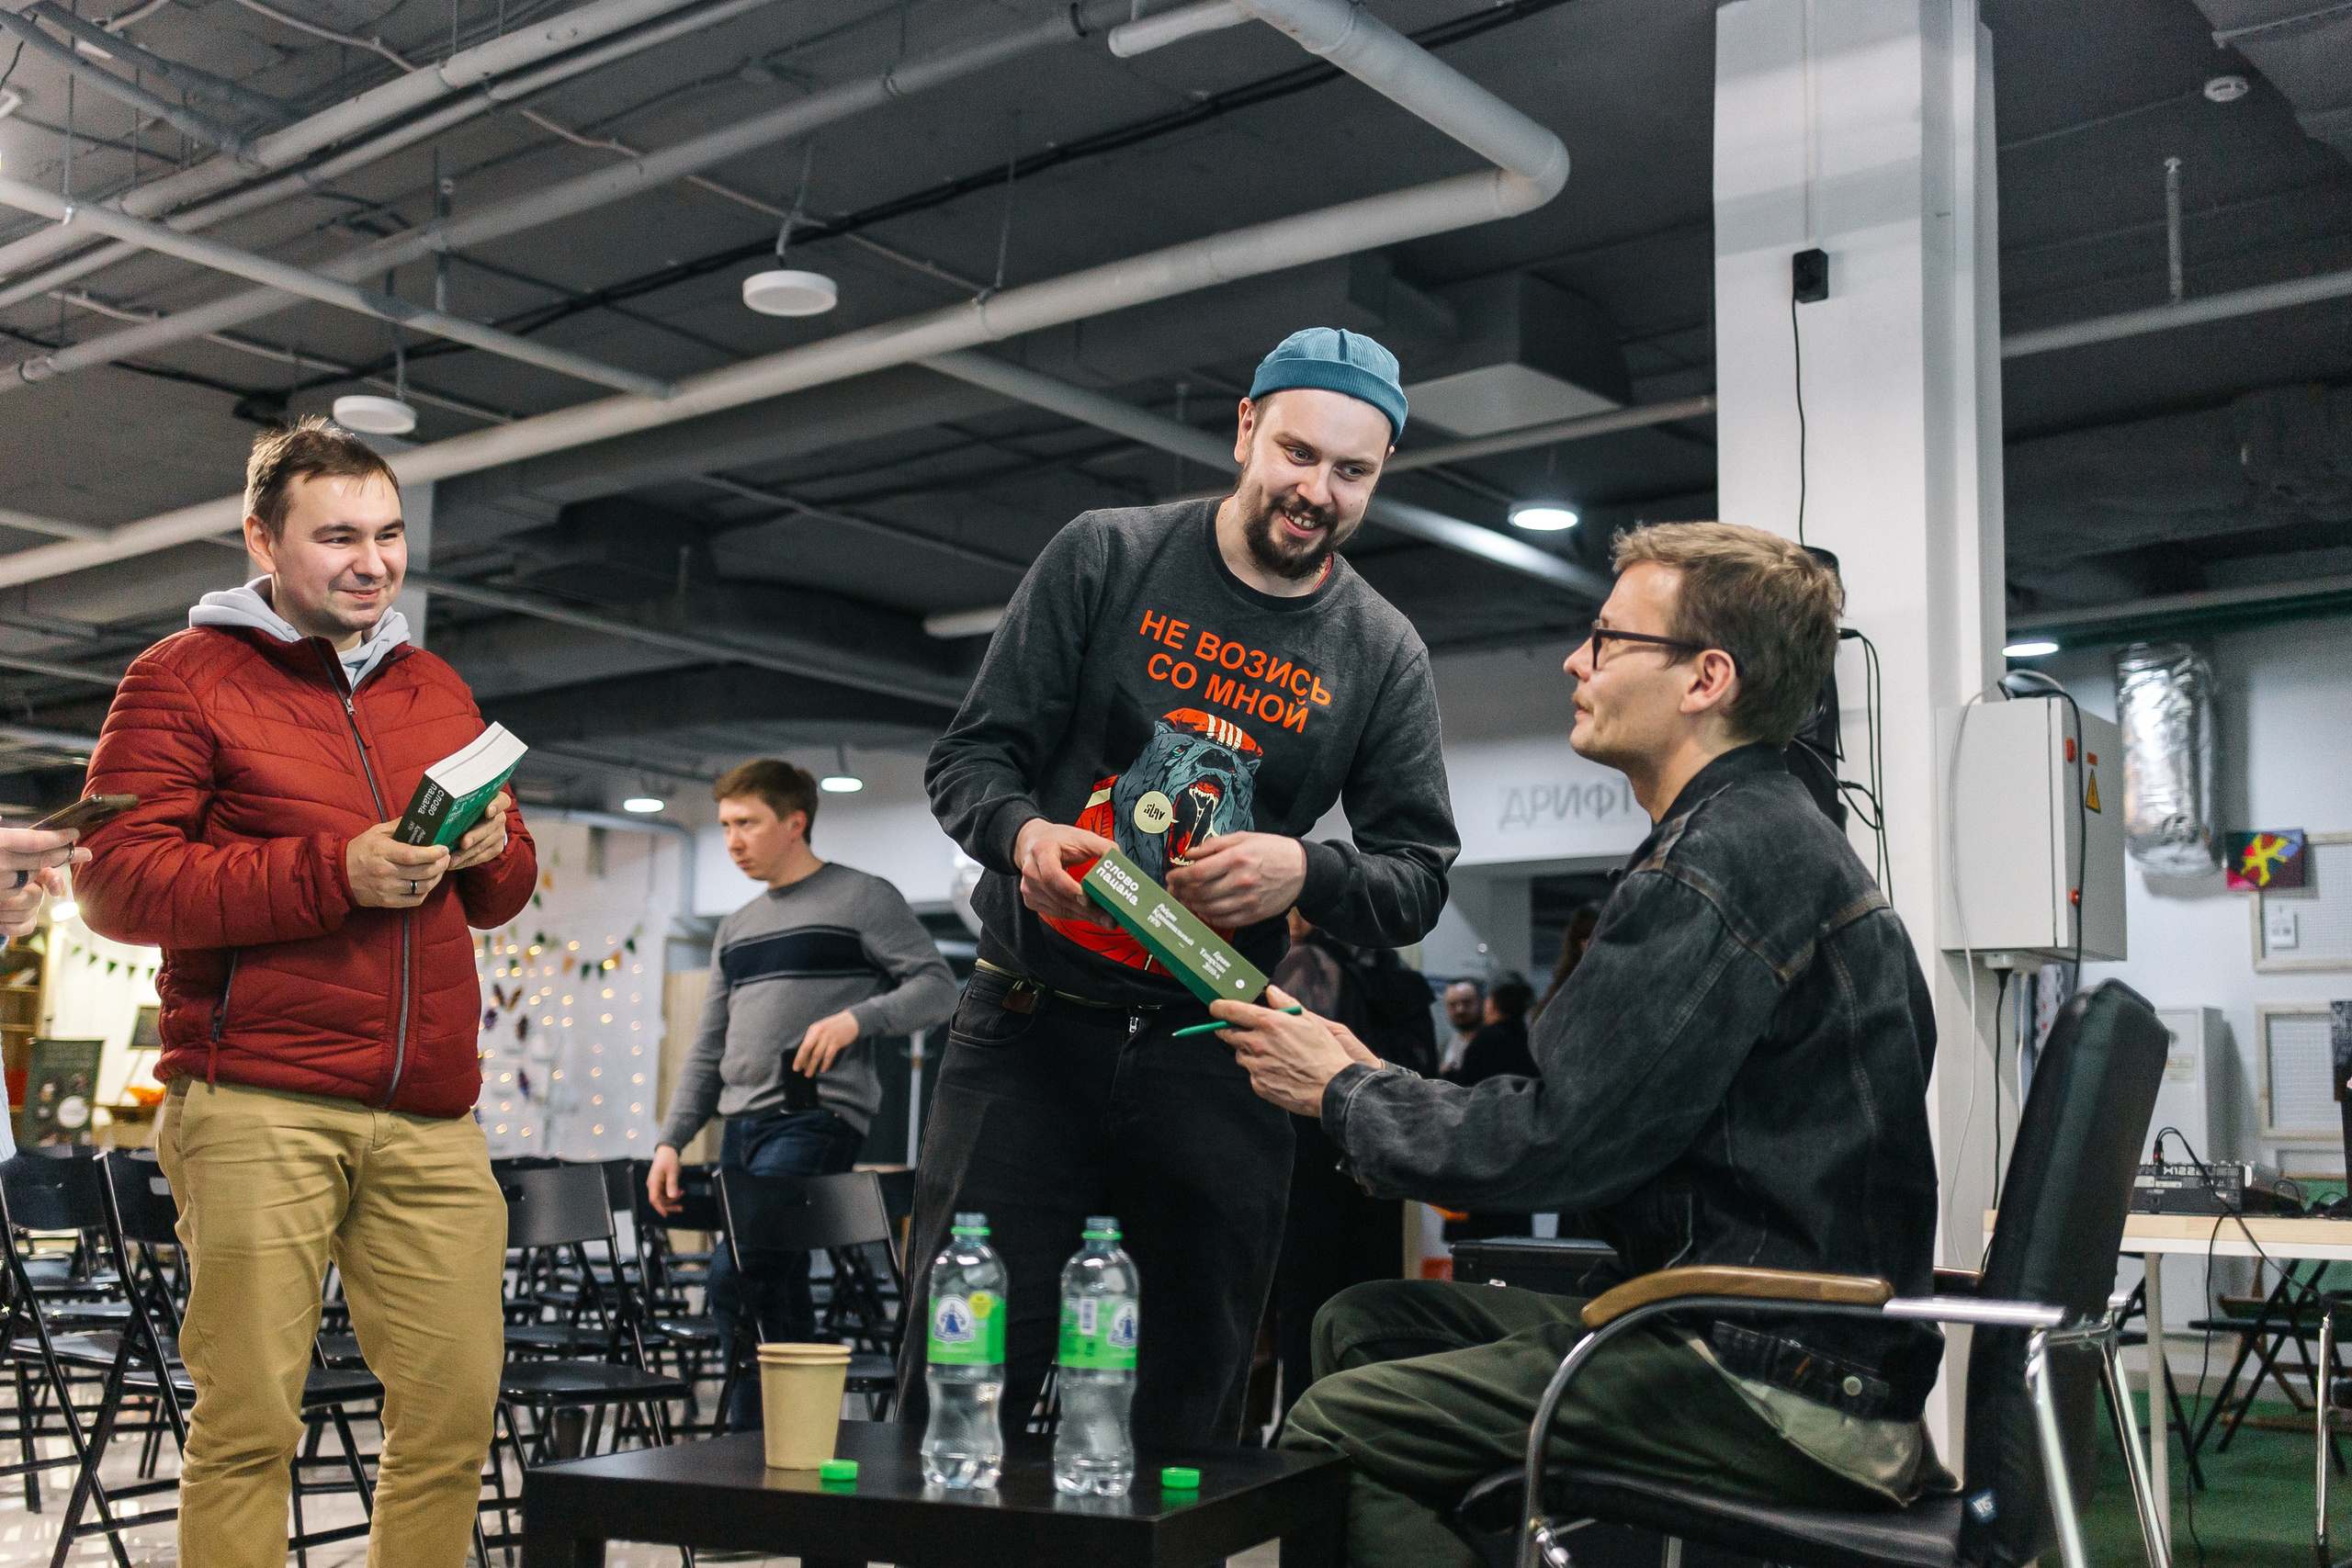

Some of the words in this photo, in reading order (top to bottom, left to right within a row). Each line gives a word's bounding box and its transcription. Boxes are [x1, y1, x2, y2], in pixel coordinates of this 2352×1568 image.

[1139, 609, 1190, 650] НЕ
[1194, 631, 1331, 706] ВОЗИСЬ
[1148, 653, 1197, 690] СО
[1204, 673, 1309, 734] МНОЙ
[418, 783, 437, 815] пацана
[428, 789, 445, 817] слово
[1096, 867, 1138, 906] пацана
[1103, 860, 1139, 891] слово
